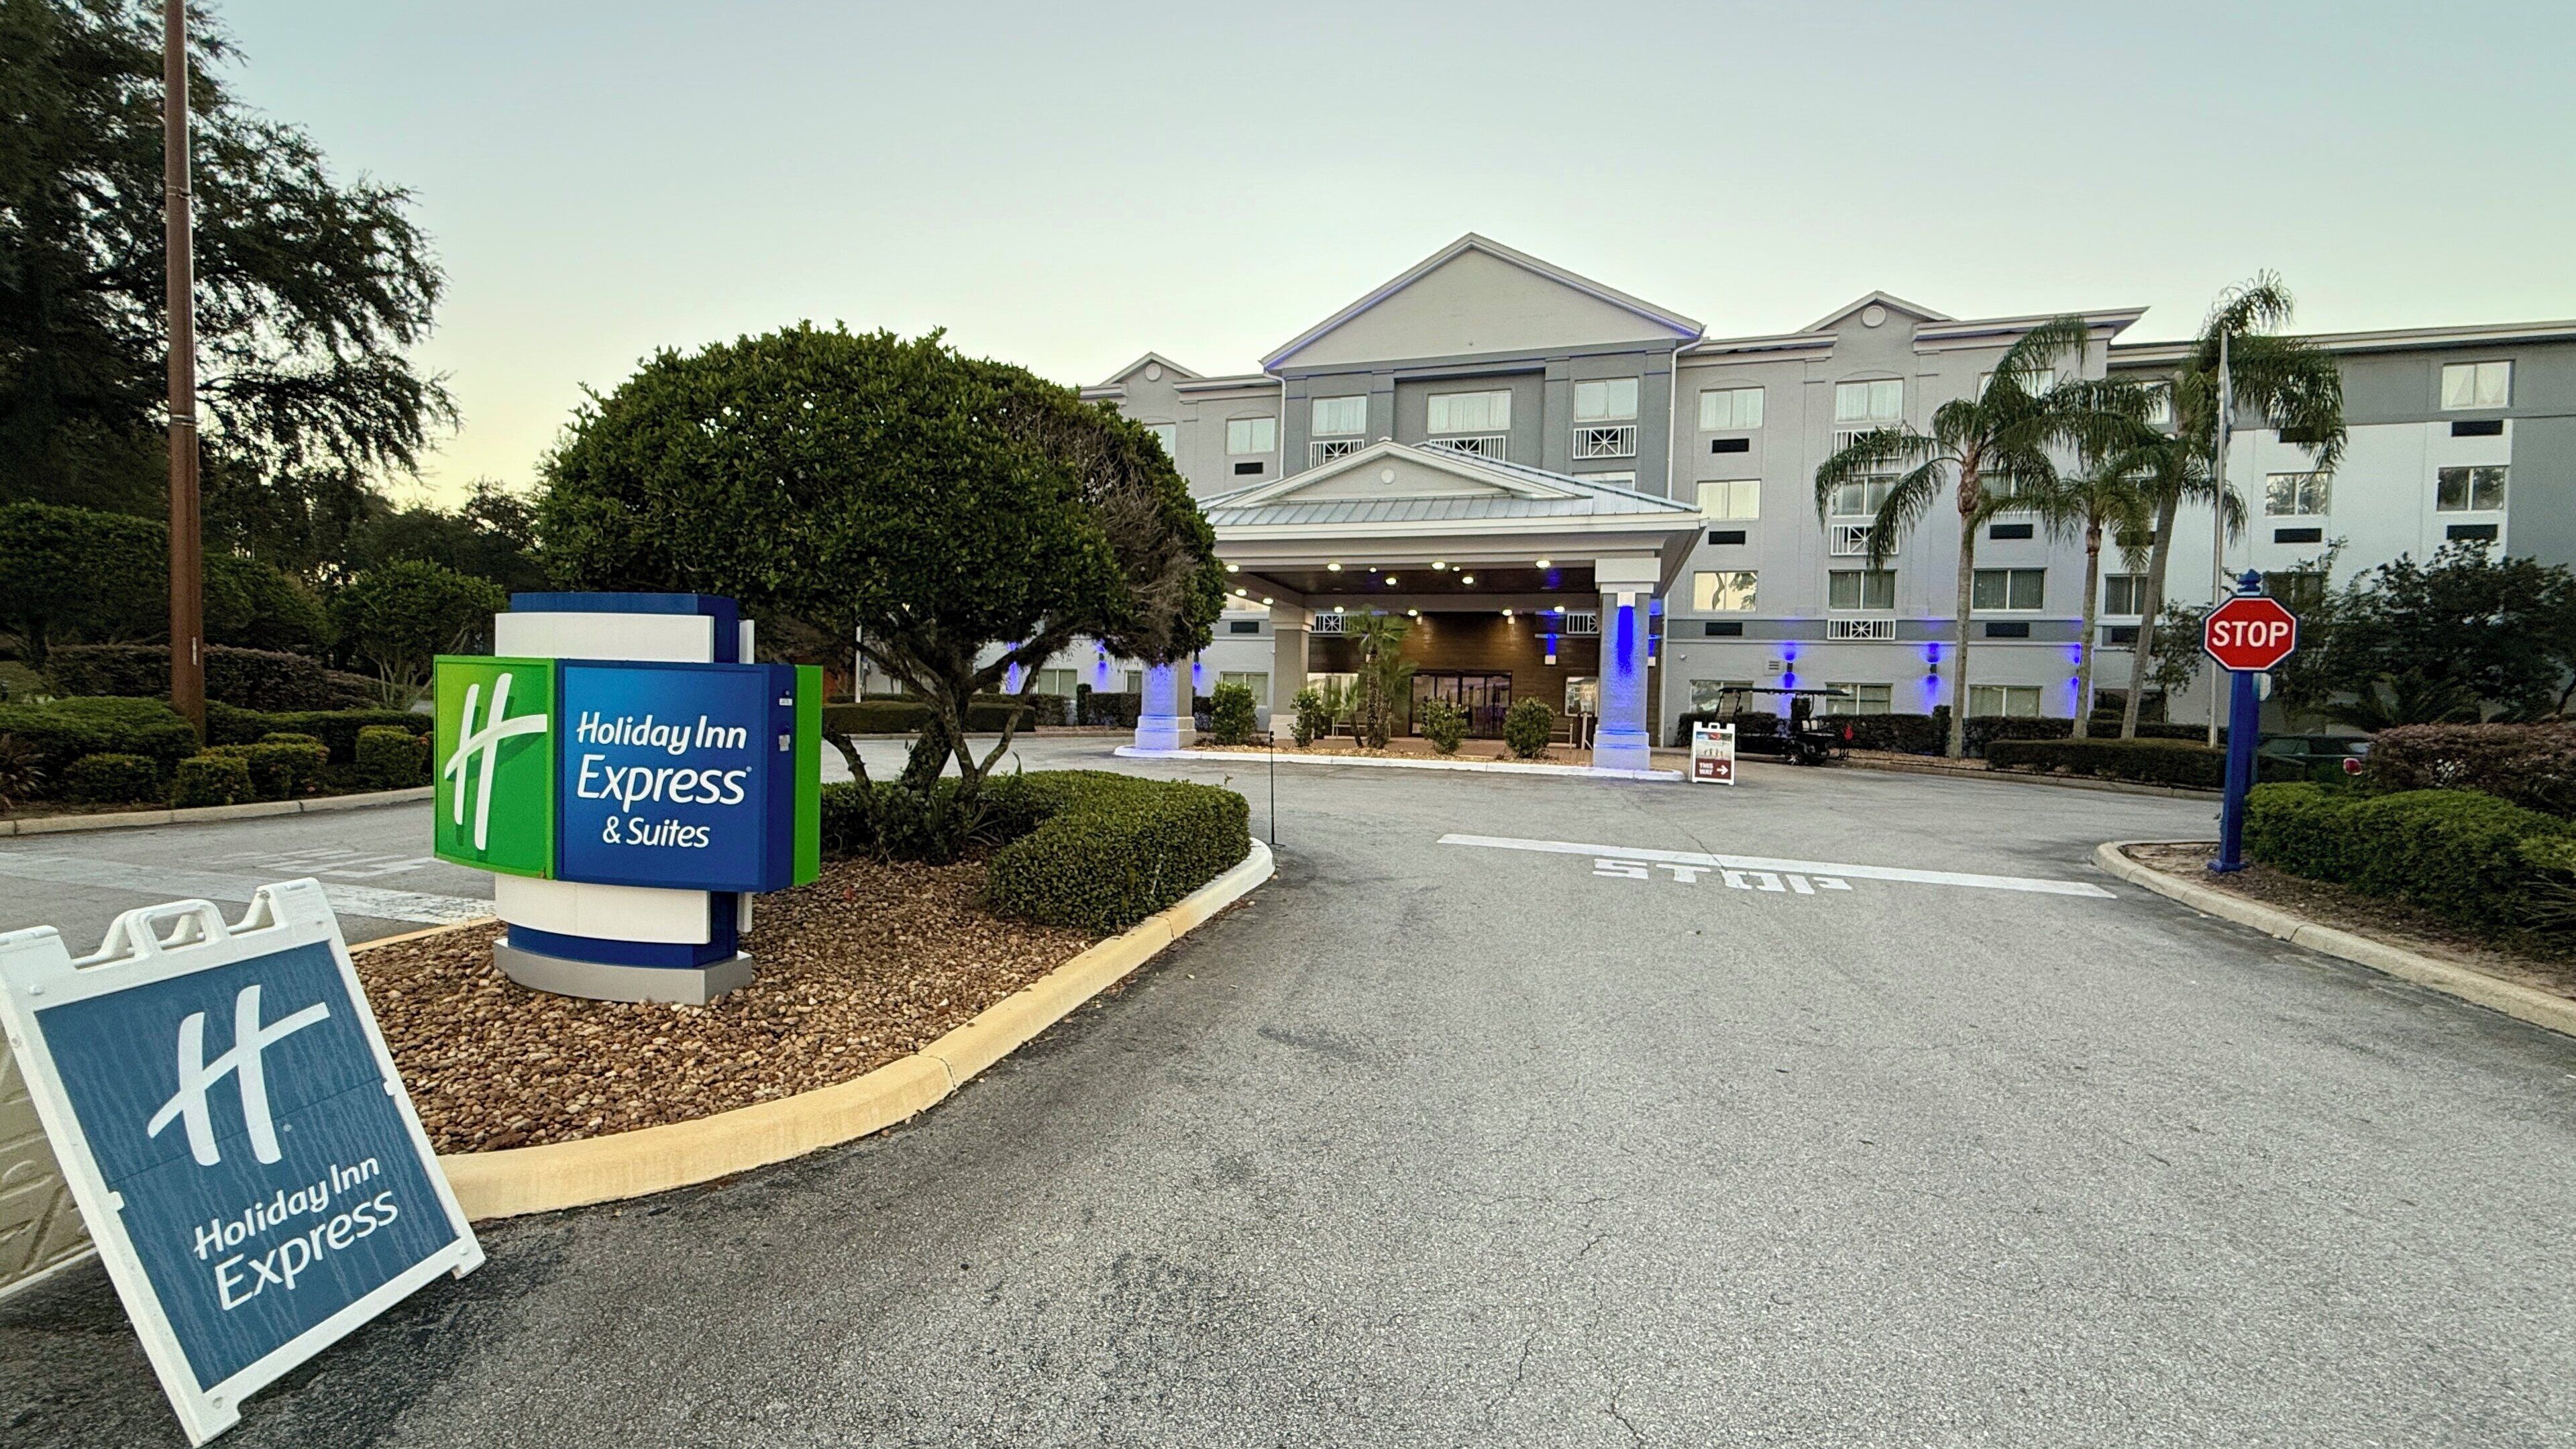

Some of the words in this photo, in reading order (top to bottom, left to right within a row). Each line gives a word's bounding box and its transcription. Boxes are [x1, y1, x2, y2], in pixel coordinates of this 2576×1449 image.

[2212, 621, 2289, 647] STOP
[576, 711, 691, 755] Holiday
[695, 715, 747, 749] Inn
[577, 754, 747, 813] Express
[602, 816, 621, 843] &
[626, 817, 710, 848] Suites
[1592, 858, 1853, 895] STOP
[193, 1181, 329, 1260] Holiday
[330, 1157, 380, 1194] Inn
[215, 1191, 398, 1311] Express
